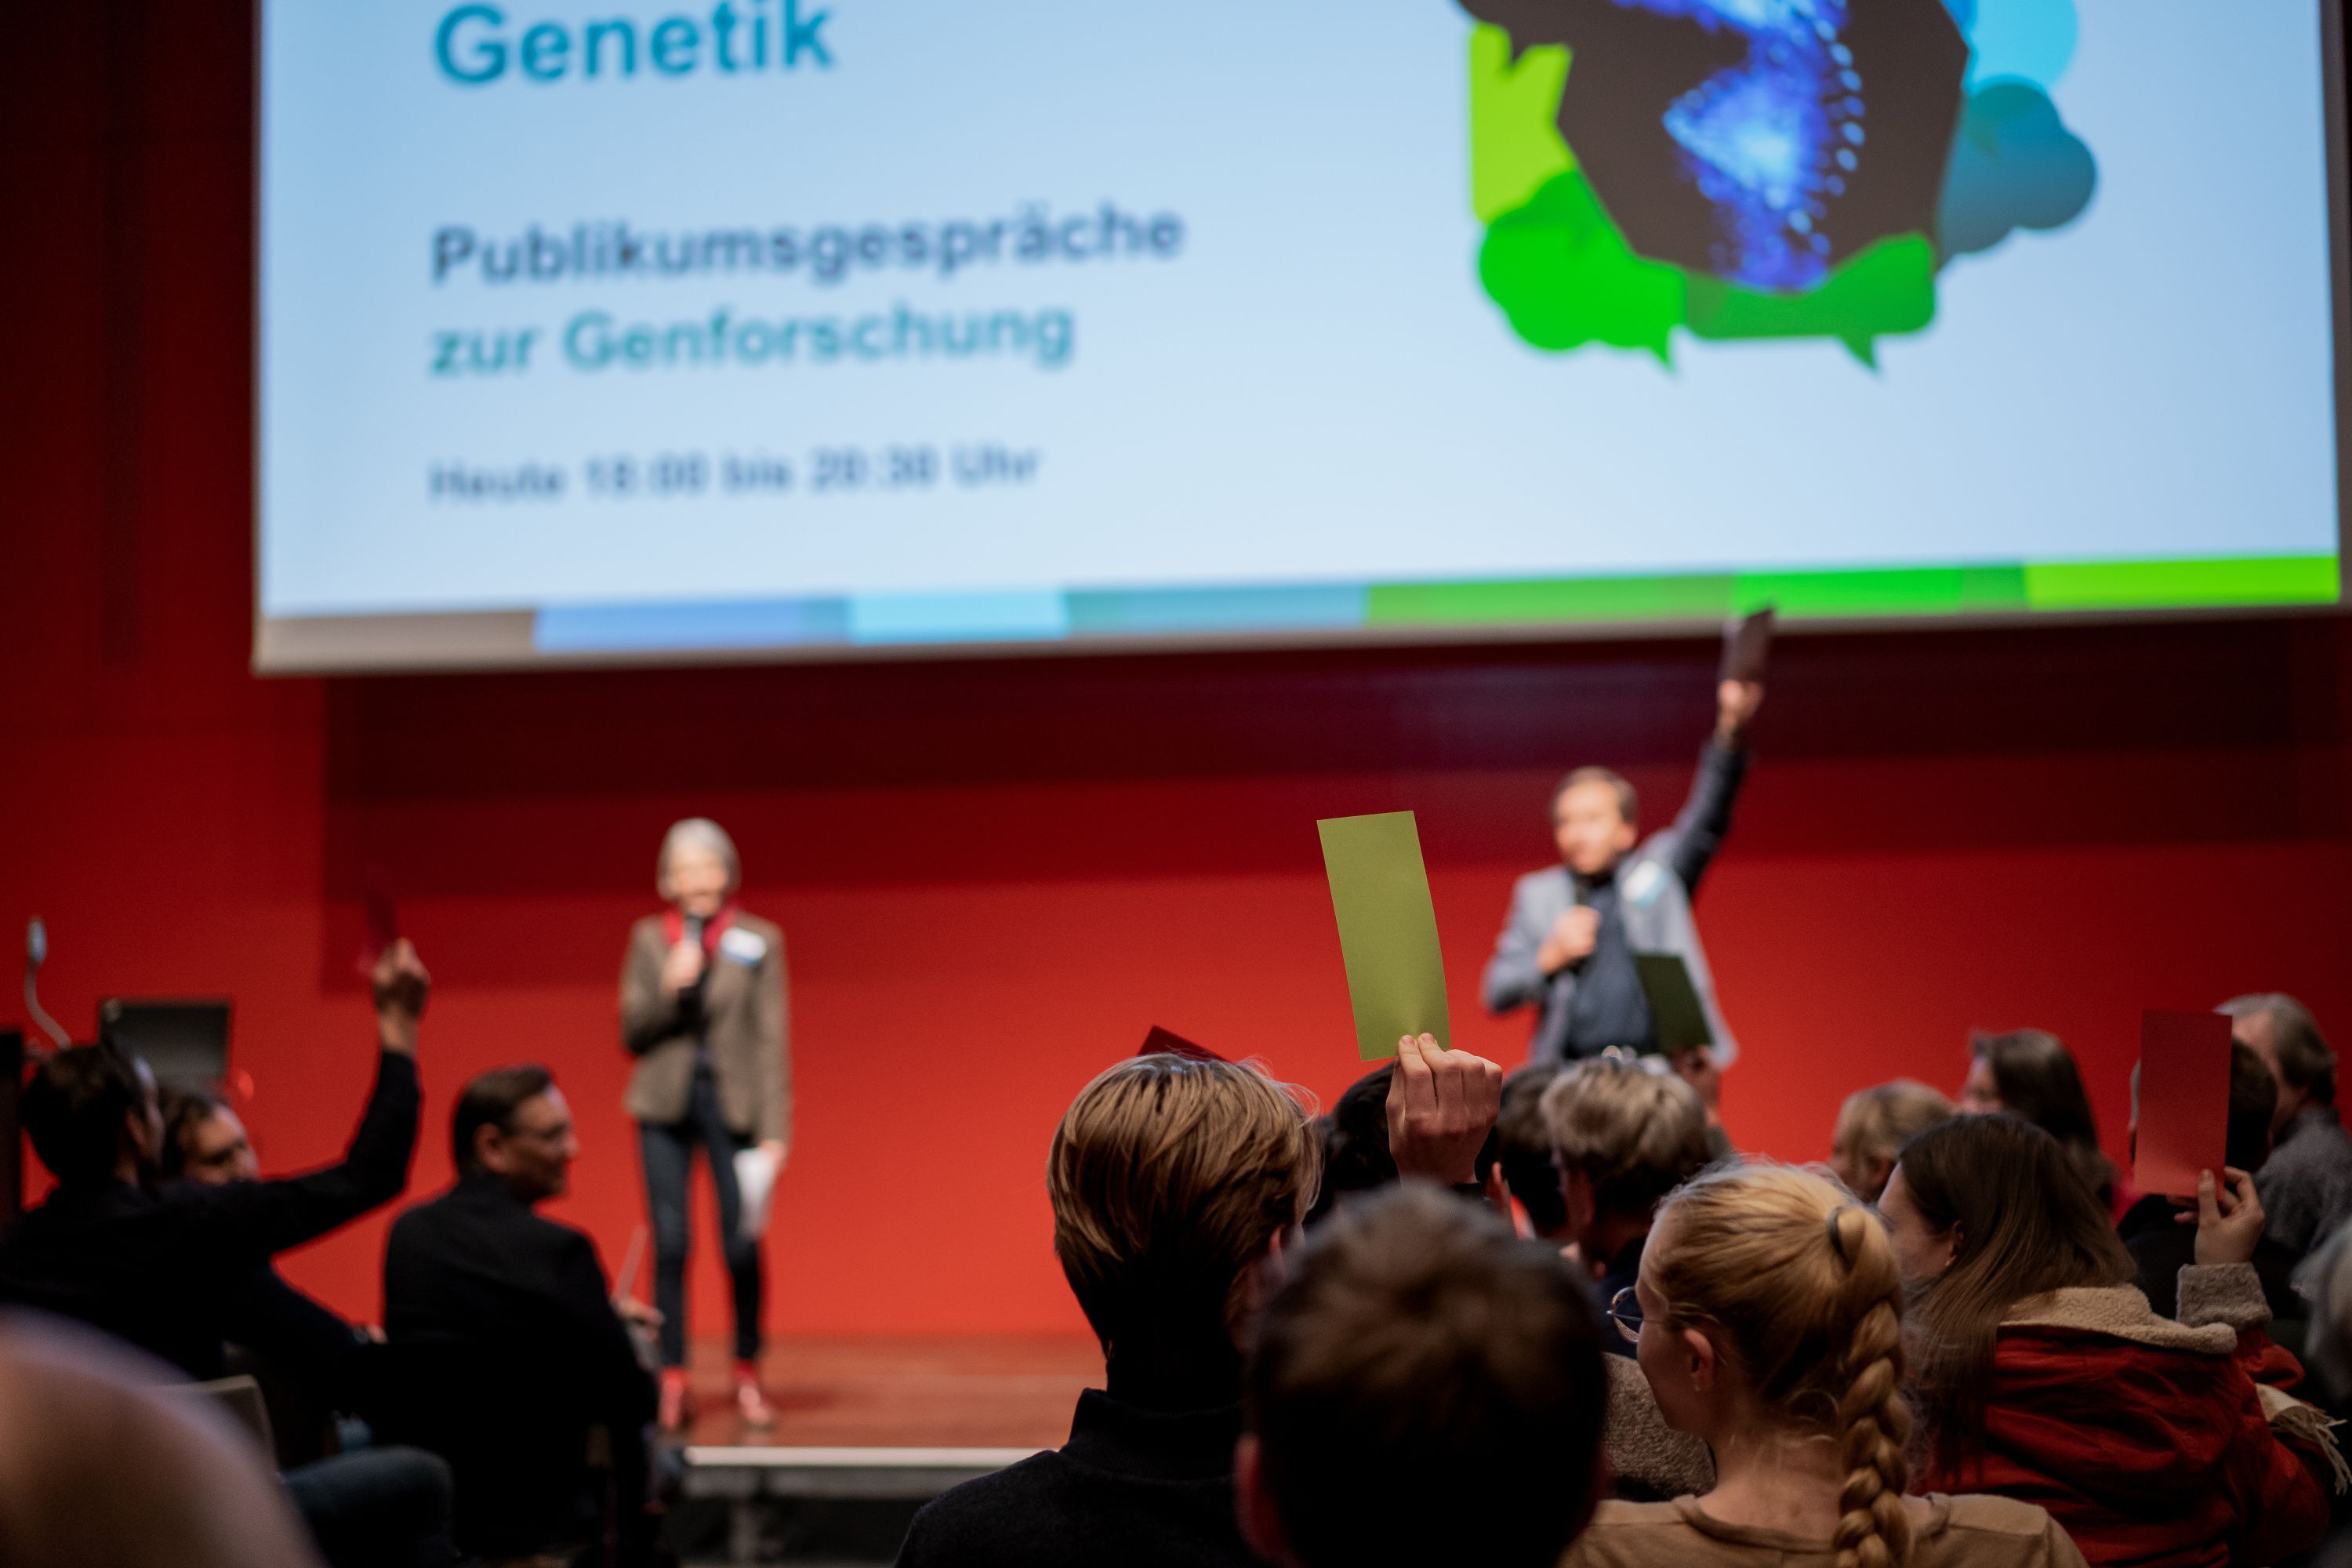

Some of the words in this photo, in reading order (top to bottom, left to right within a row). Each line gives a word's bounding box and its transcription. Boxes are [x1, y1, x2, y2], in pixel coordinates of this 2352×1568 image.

[435, 0, 833, 85] Genetik
[432, 201, 1186, 287] Publikumsgespräche
[430, 326, 541, 376] zur
[562, 299, 1076, 372] Genforschung
[427, 458, 565, 503] Heute
[722, 448, 793, 494] bis
[952, 439, 1041, 486] Uhr
